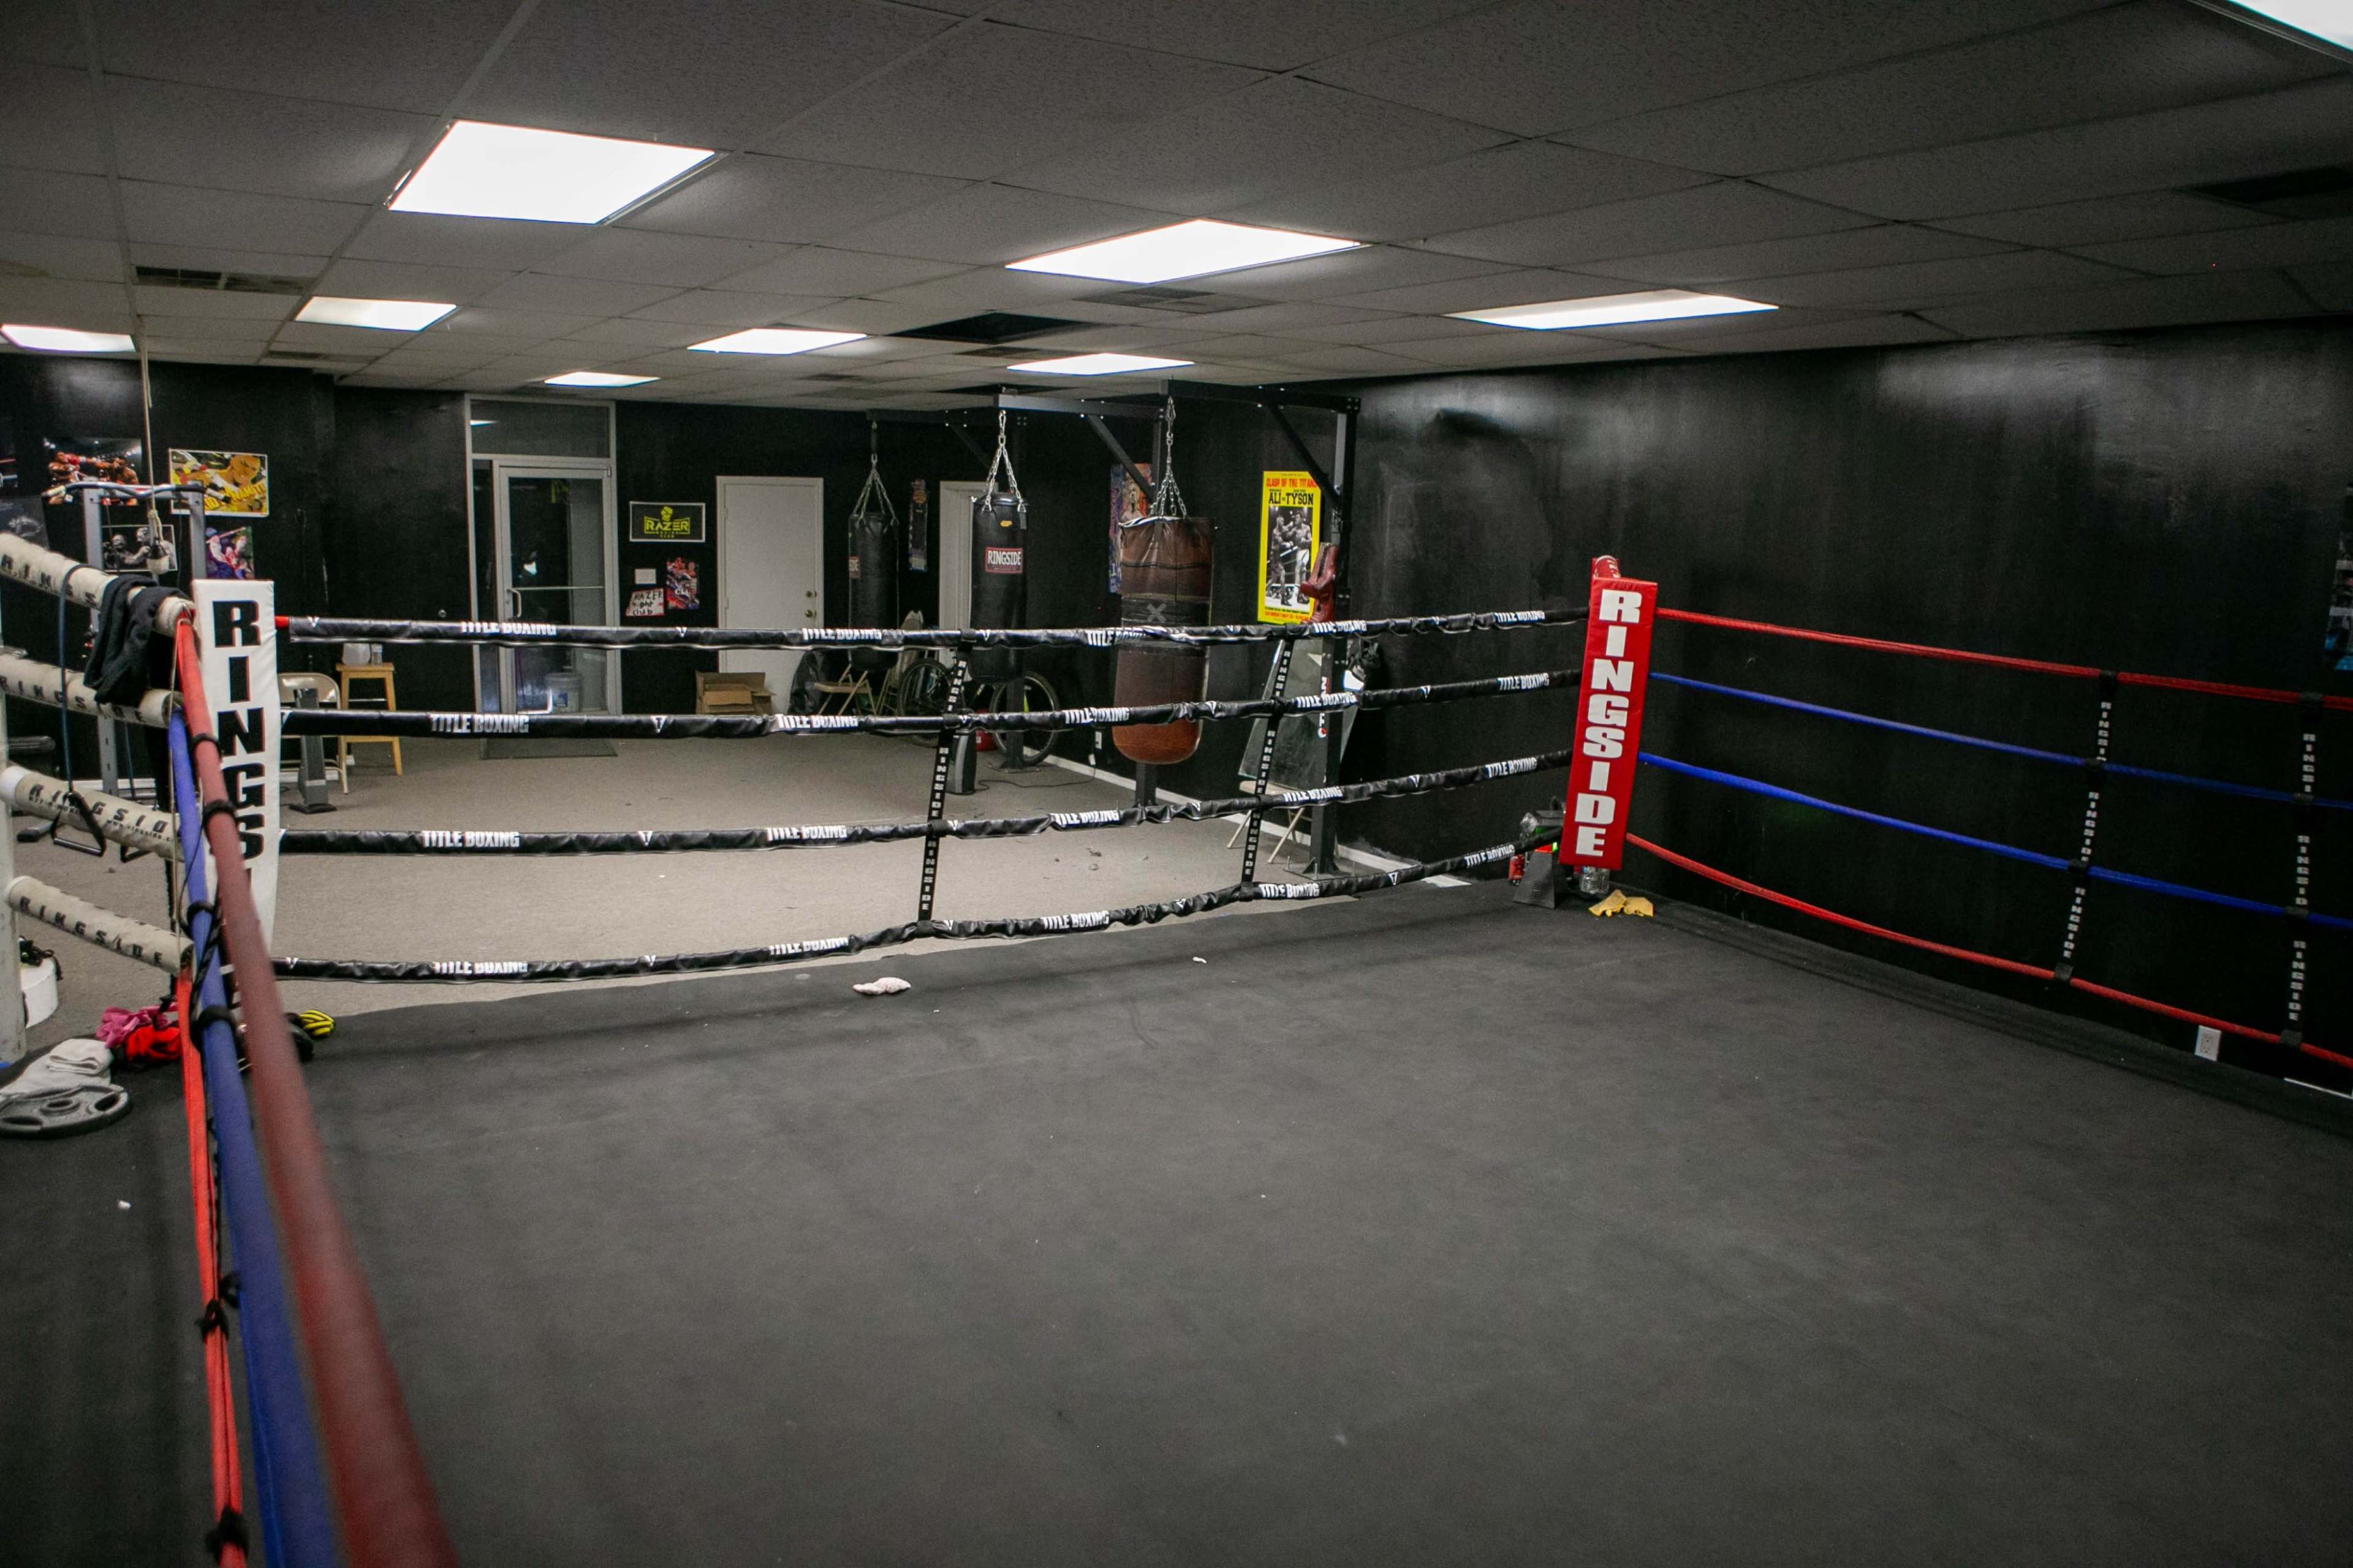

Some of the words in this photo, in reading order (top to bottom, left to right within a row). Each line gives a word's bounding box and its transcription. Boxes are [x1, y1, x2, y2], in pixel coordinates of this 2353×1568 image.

[1268, 492, 1281, 504] ALI
[1286, 493, 1314, 505] TYSON
[646, 520, 689, 531] RAZER
[988, 550, 1021, 565] RINGSIDE
[1495, 612, 1517, 623] TITLE
[460, 621, 499, 633] TITLE
[1085, 630, 1114, 646] TITLE
[1498, 676, 1520, 691] TITLE
[1520, 673, 1550, 689] BOXING
[430, 713, 471, 733] TITLE
[474, 714, 529, 733] BOXING
[1061, 707, 1093, 724] TITLE
[1574, 588, 1643, 857] RINGSIDE
[1485, 762, 1508, 778] TITLE
[1509, 757, 1537, 774] BOXING
[931, 748, 949, 817] RINGSIDE
[422, 830, 463, 847] TITLE
[464, 831, 520, 847] BOXING
[765, 828, 801, 841] TITLE
[801, 825, 847, 839] BOXING
[1464, 854, 1487, 868] TITLE
[922, 841, 936, 910] RINGSIDE
[2295, 835, 2311, 906] RINGSID
[1040, 916, 1070, 930] TITLE
[1070, 910, 1109, 928] BOXING
[20, 895, 164, 966] RINGSIDE
